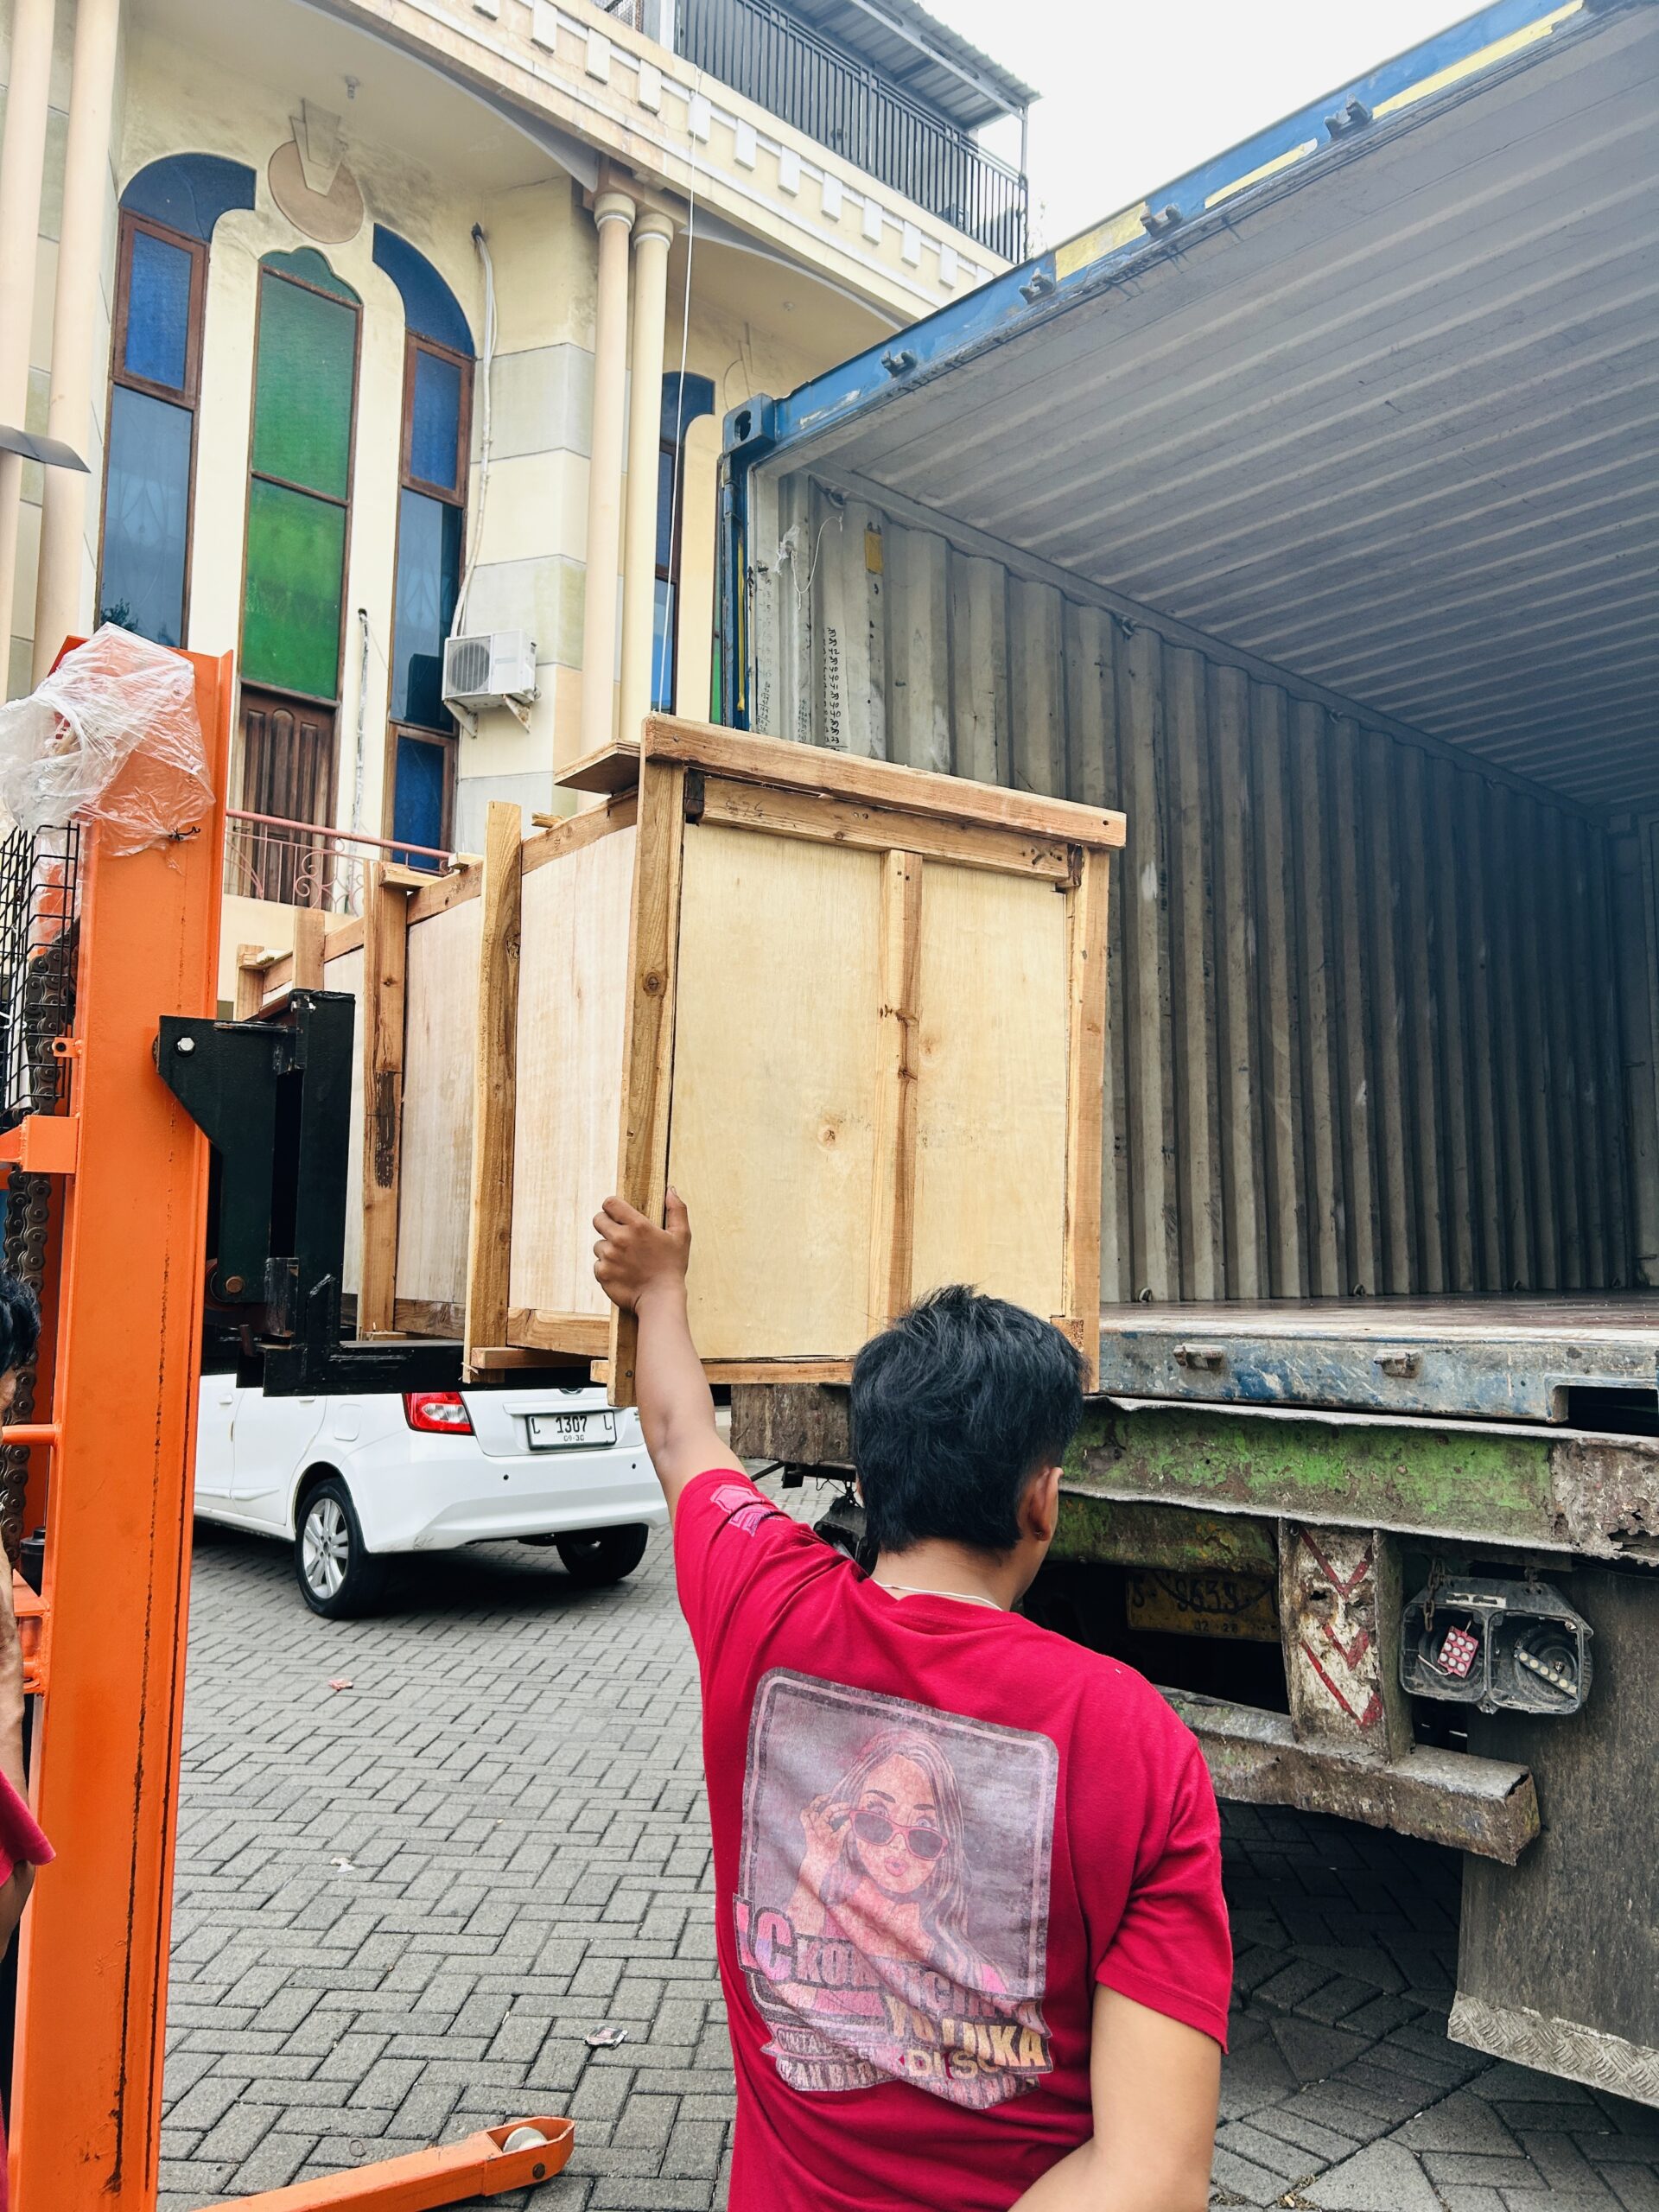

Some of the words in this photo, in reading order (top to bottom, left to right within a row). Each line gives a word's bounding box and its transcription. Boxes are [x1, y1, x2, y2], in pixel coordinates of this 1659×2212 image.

[829, 674, 839, 683] 40
[830, 710, 841, 719] 40
[531, 1417, 540, 1433] L
[556, 1415, 587, 1433] 1307
[603, 1414, 612, 1431] L
[734, 1898, 793, 1982] LC
